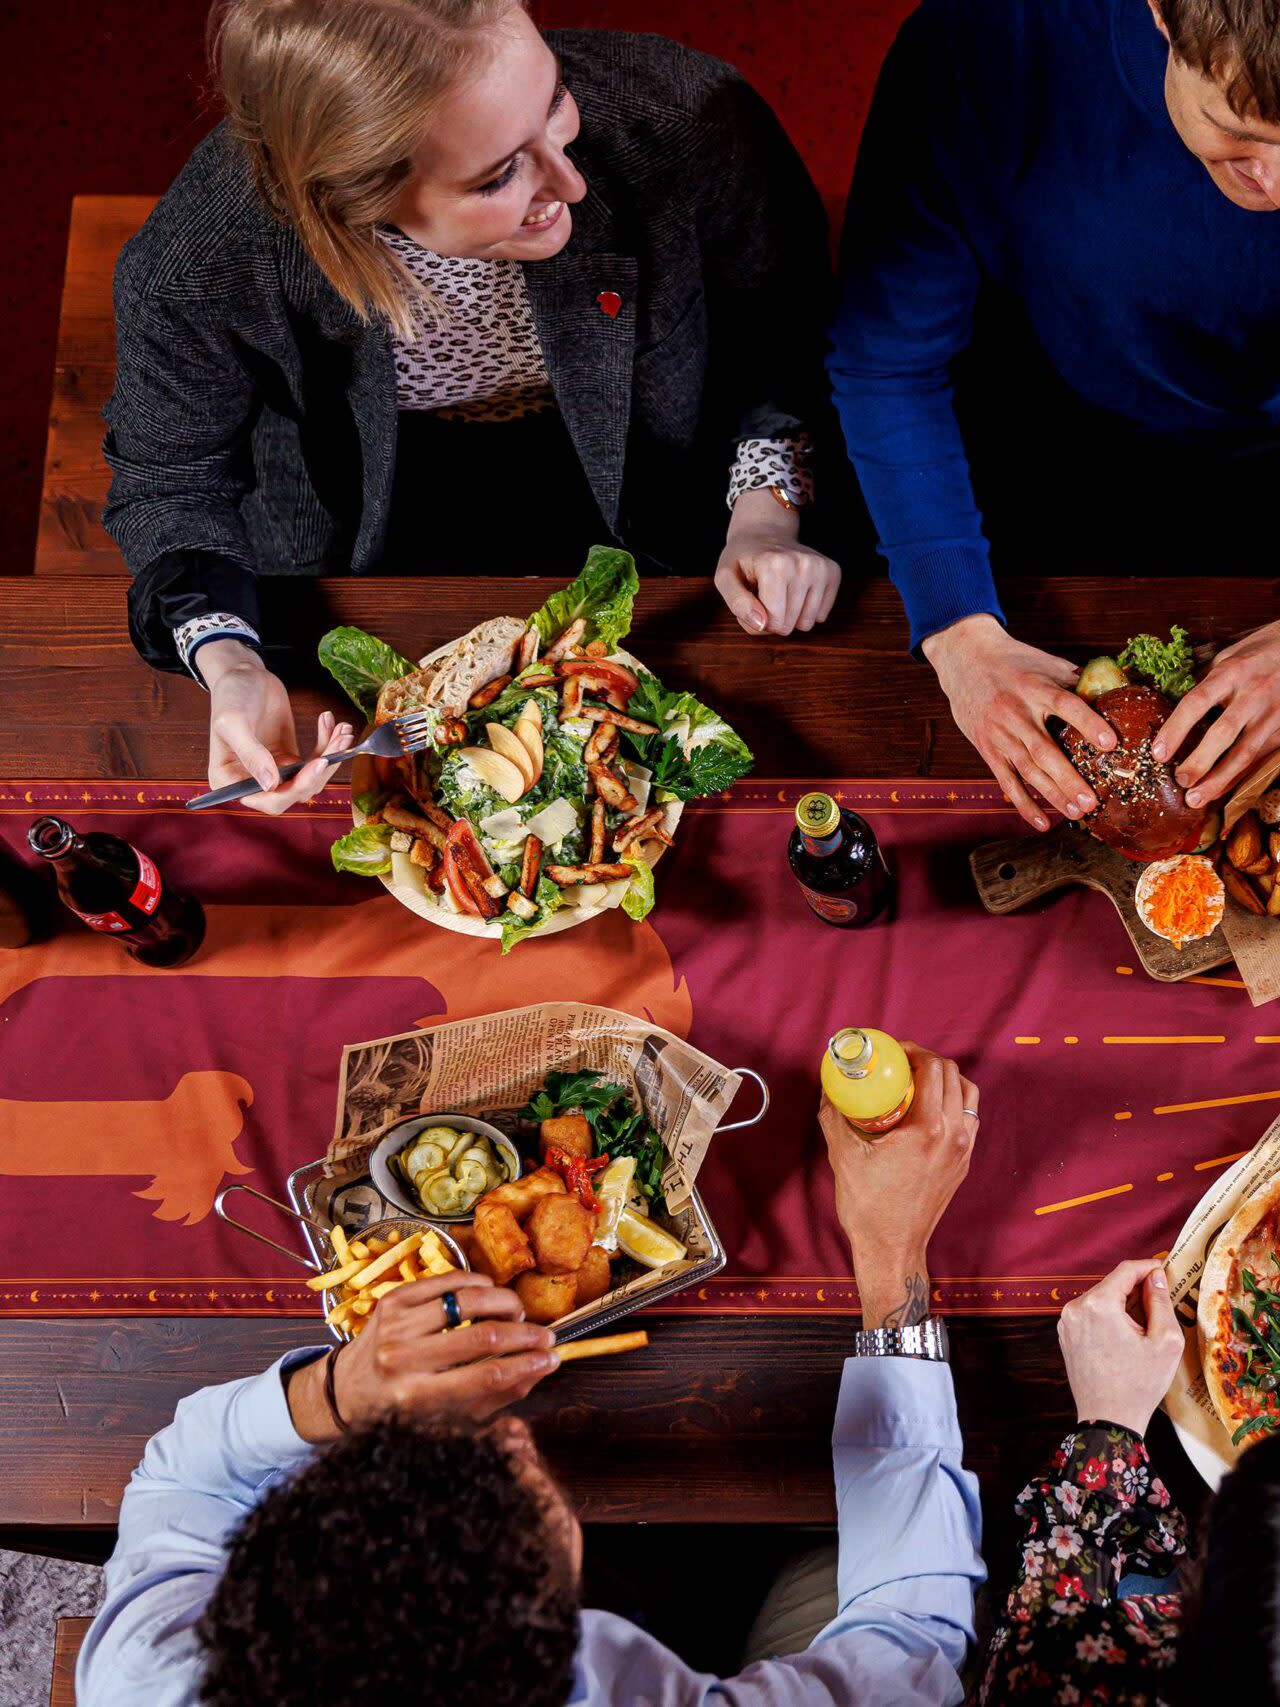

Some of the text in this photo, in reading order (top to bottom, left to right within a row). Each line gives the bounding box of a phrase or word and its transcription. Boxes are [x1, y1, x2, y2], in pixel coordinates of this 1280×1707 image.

[548, 1018, 557, 1038] OPEN
[556, 1020, 564, 1034] AND
[546, 1041, 553, 1050] IN
[1185, 1259, 1204, 1279] The
